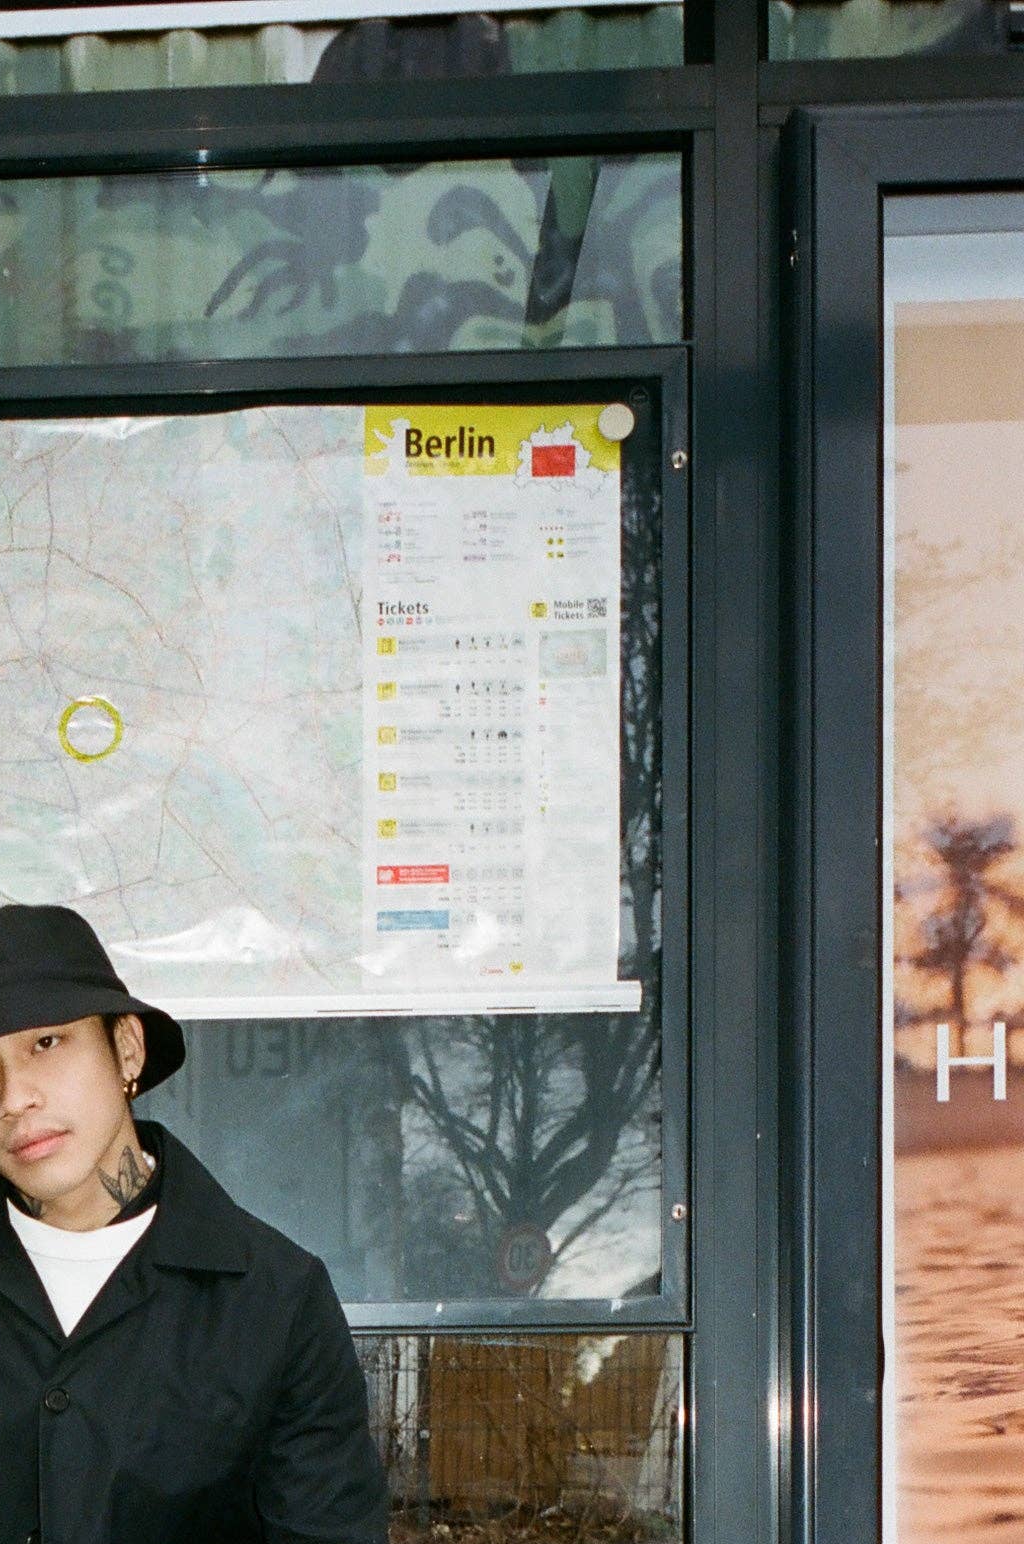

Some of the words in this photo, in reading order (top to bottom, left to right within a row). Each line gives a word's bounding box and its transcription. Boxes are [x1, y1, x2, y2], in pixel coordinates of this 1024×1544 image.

[405, 426, 495, 459] Berlin
[377, 600, 430, 616] Tickets
[936, 1021, 1007, 1103] H
